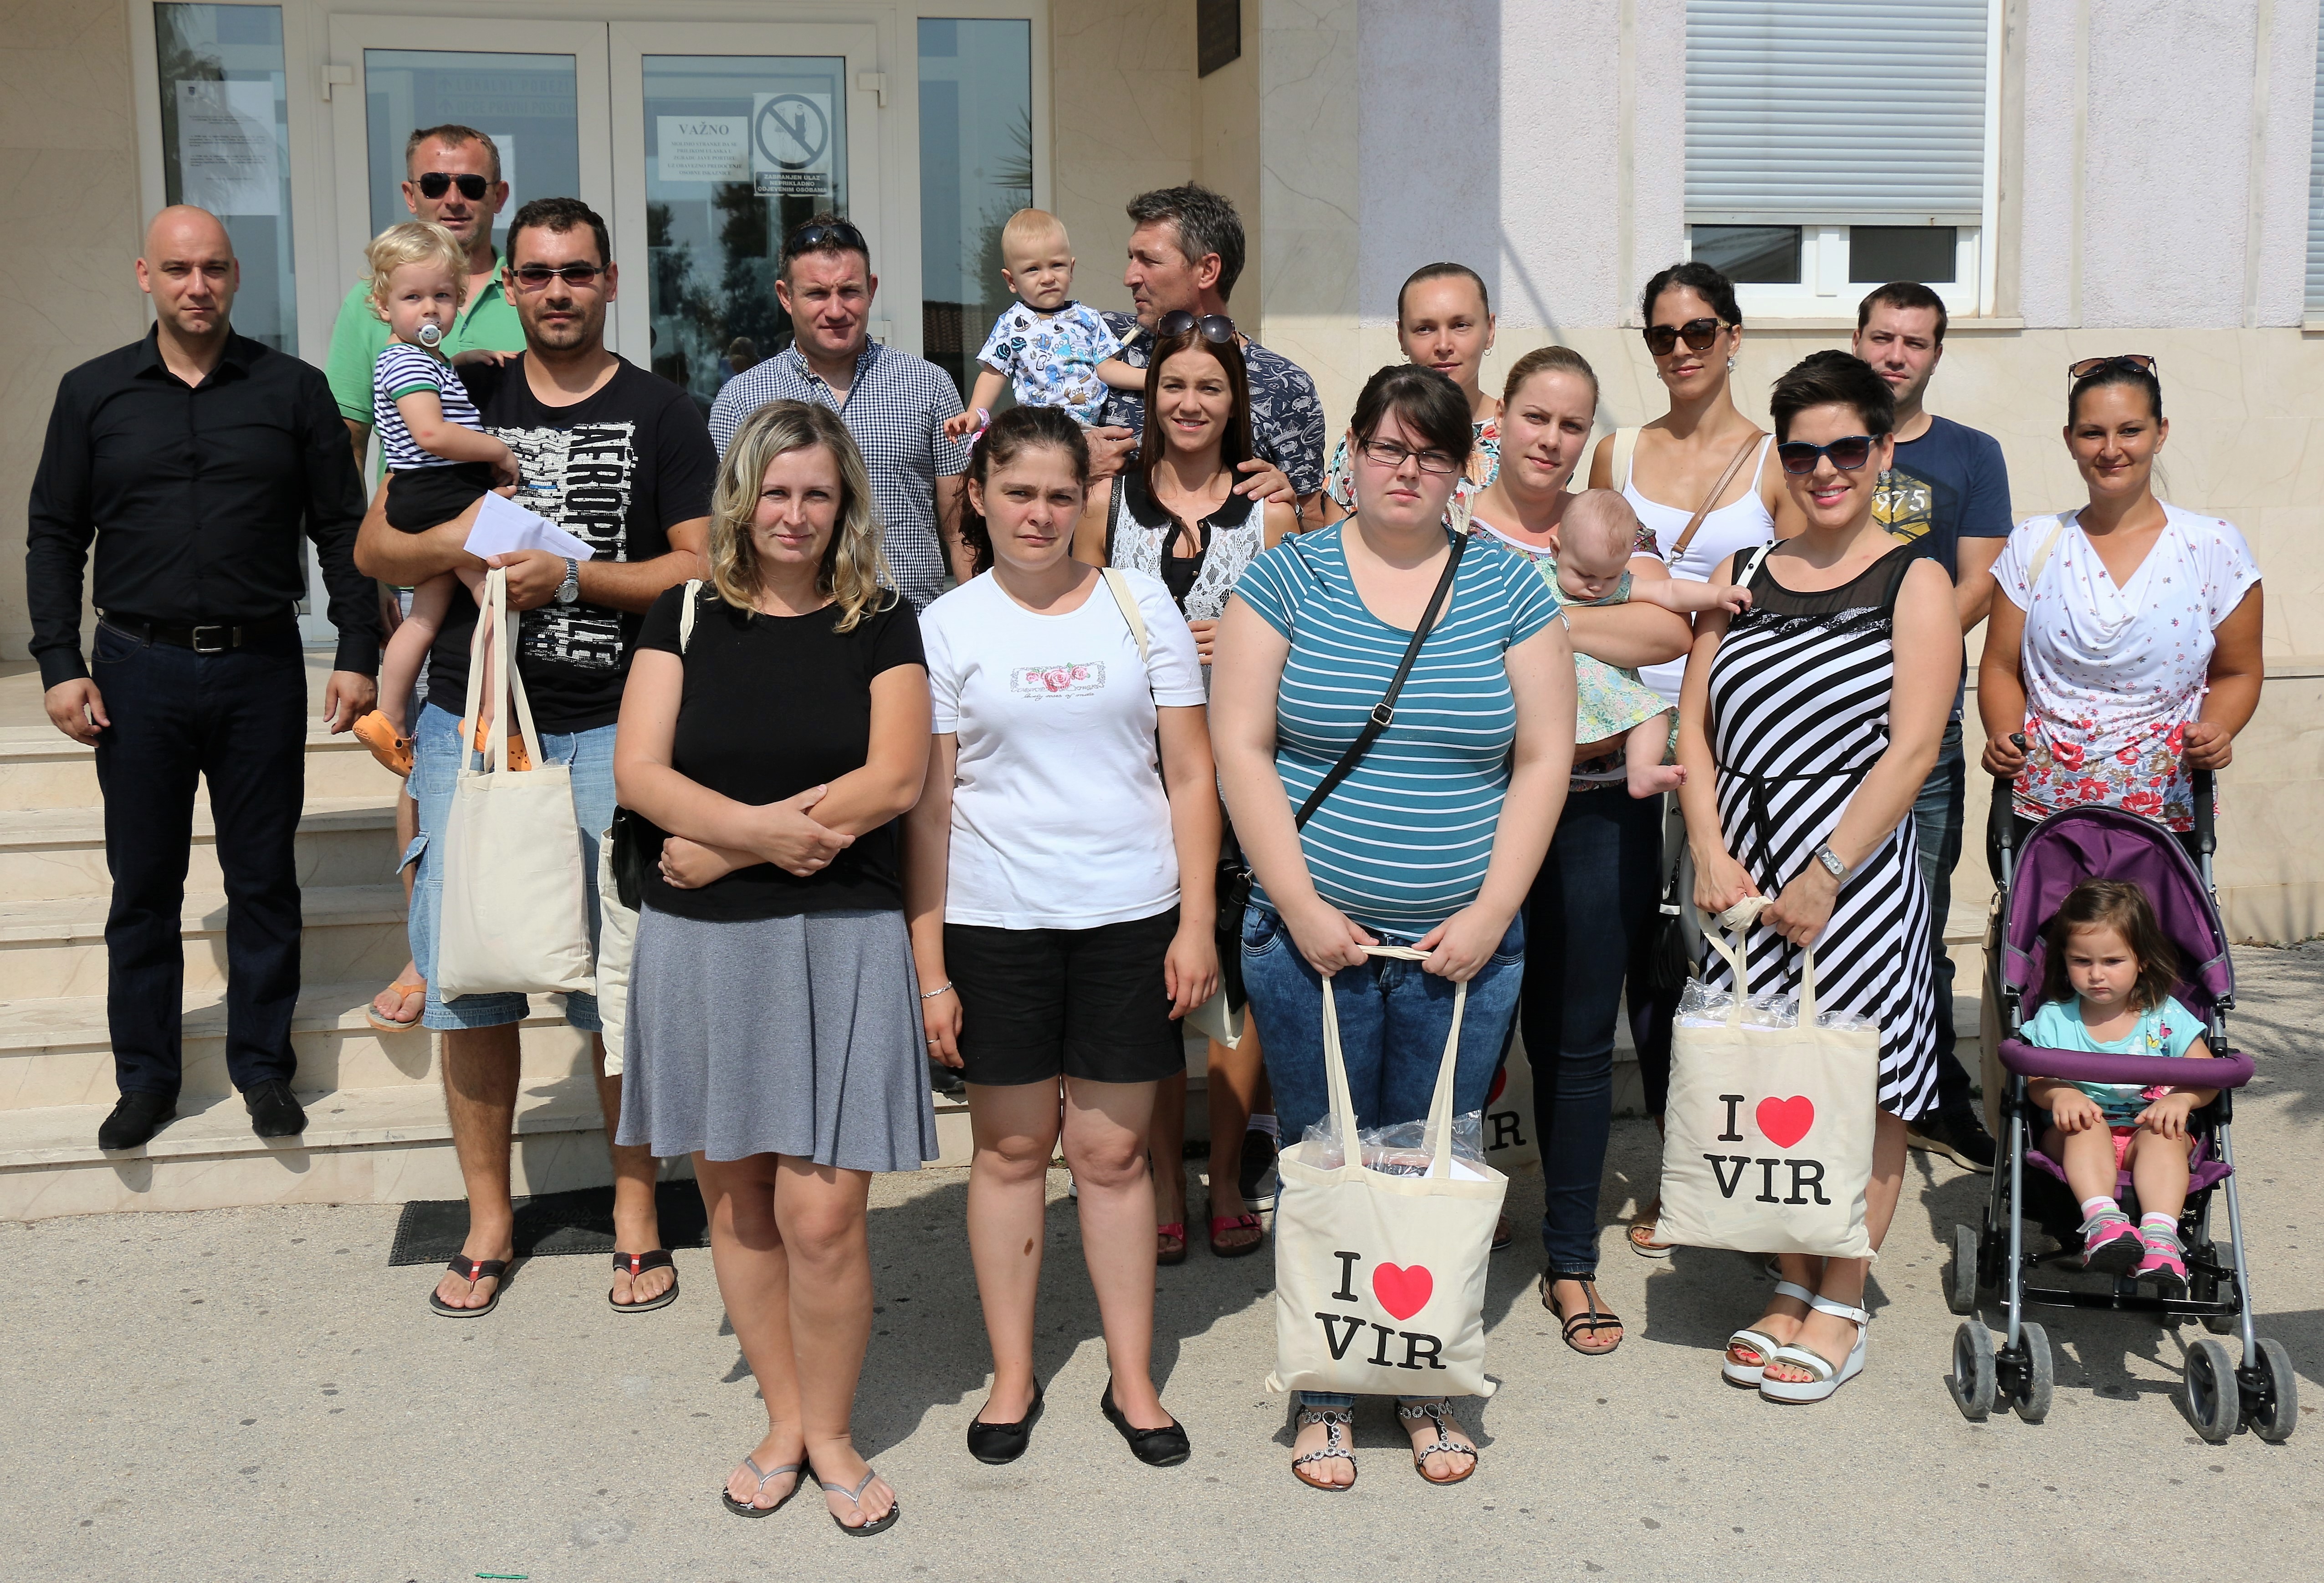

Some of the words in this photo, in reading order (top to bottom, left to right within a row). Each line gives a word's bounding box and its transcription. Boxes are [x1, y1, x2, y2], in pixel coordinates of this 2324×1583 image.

[678, 121, 729, 135] VAŽNO
[564, 429, 627, 661] AEROPOALE
[1717, 1094, 1744, 1142] I
[1703, 1153, 1831, 1206] VIR
[1331, 1251, 1361, 1302] I
[1315, 1312, 1447, 1370] VIR
